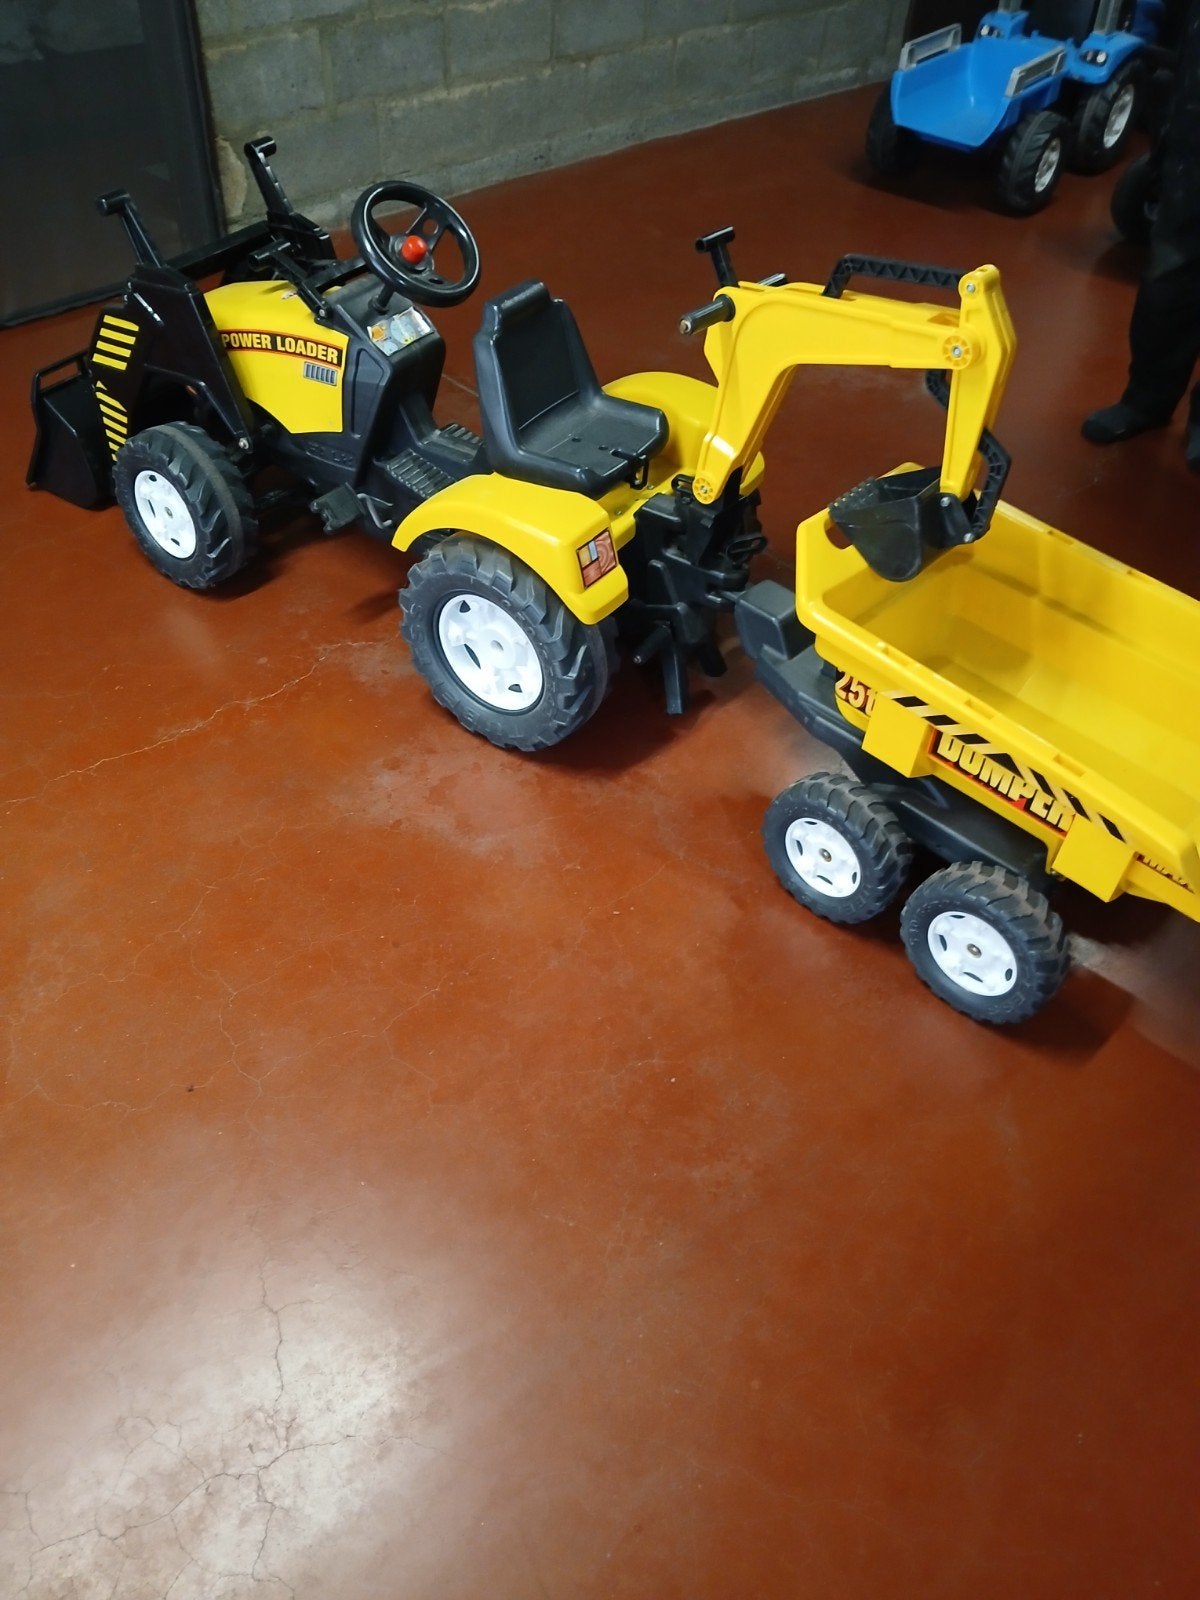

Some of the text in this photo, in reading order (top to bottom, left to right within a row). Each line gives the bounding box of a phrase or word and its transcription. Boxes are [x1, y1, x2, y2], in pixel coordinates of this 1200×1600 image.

[221, 332, 339, 364] POWER LOADER
[936, 732, 1075, 832] DUMPER
